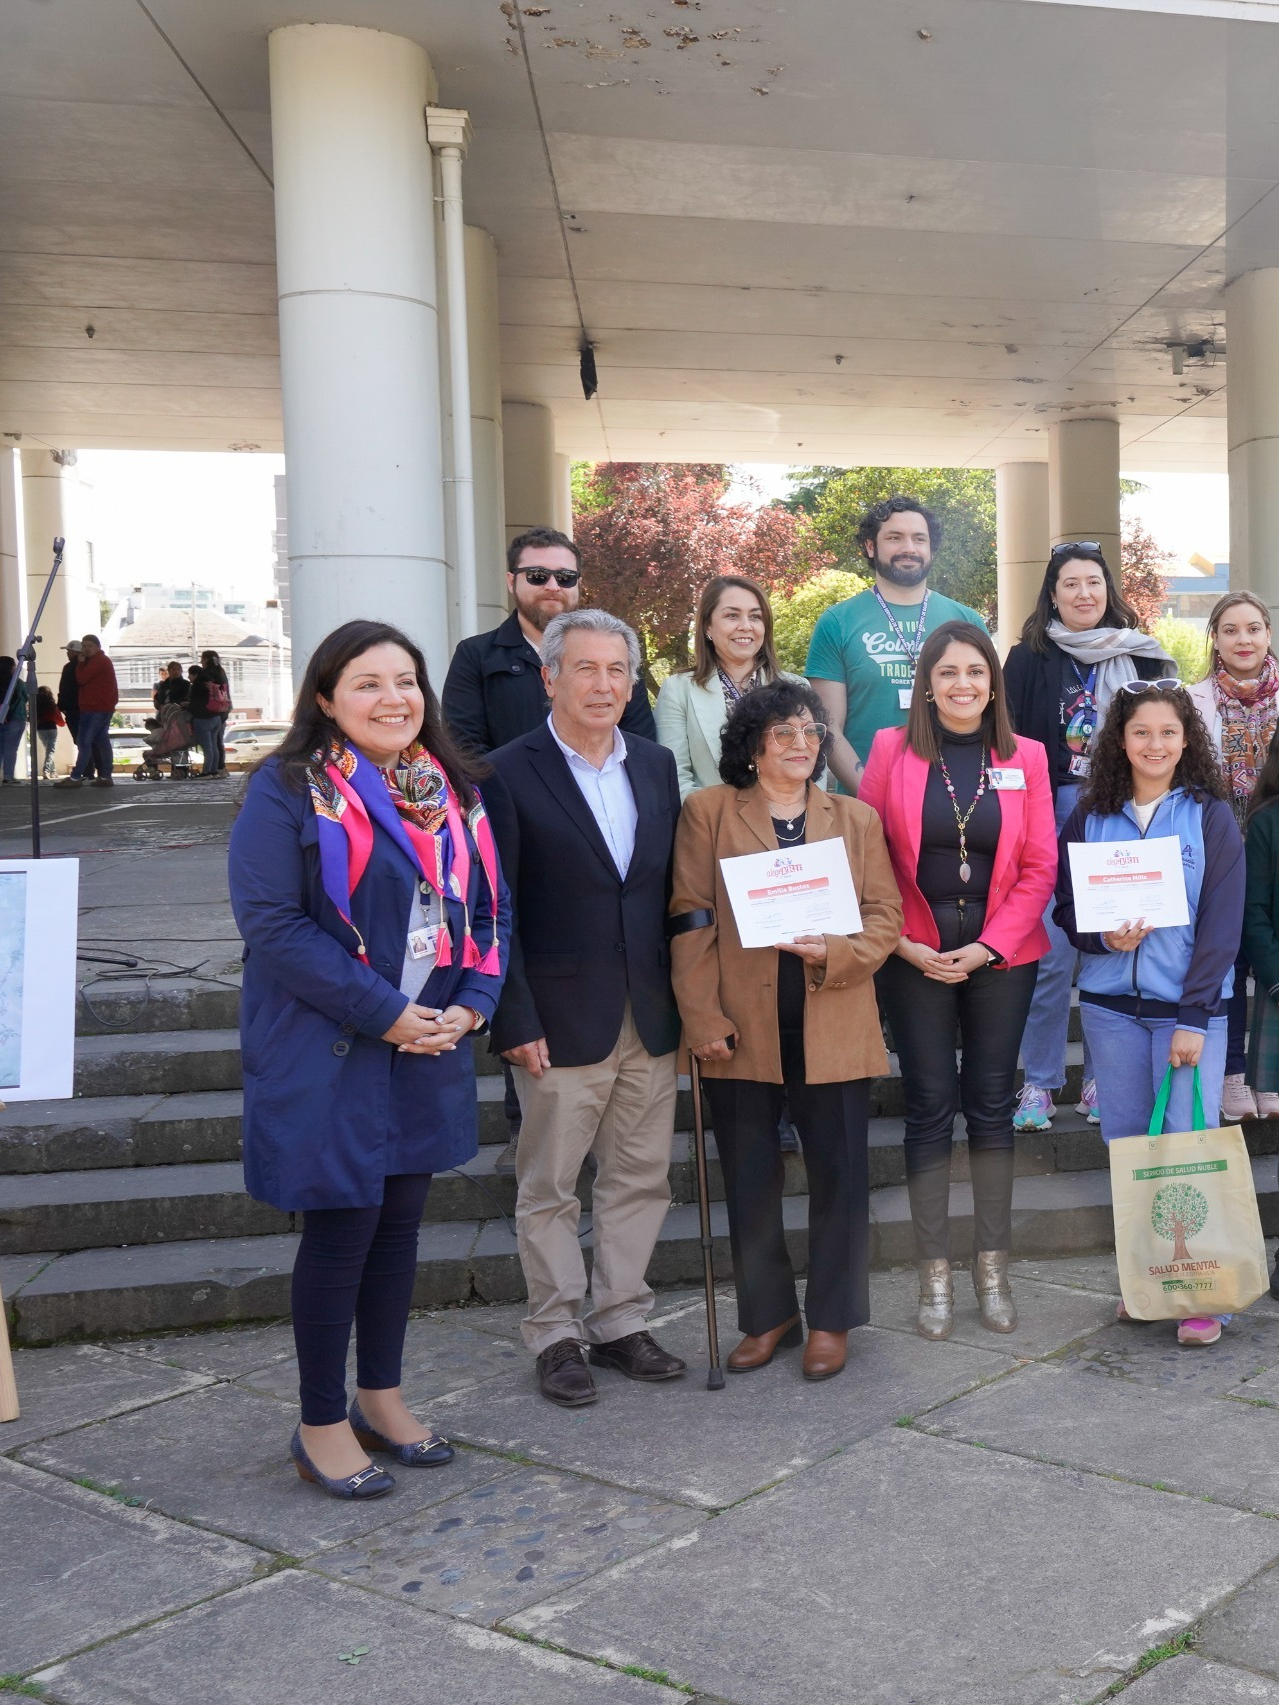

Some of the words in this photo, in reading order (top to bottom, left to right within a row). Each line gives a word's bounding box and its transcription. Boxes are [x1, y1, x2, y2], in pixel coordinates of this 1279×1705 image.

[767, 887, 787, 896] Emilia
[788, 883, 810, 893] Bustos
[1166, 1167, 1175, 1175] DE
[1175, 1165, 1197, 1174] SALUD
[1197, 1163, 1218, 1172] ÑUBLE
[1149, 1264, 1180, 1276] SALUD
[1181, 1260, 1221, 1271] MENTAL
